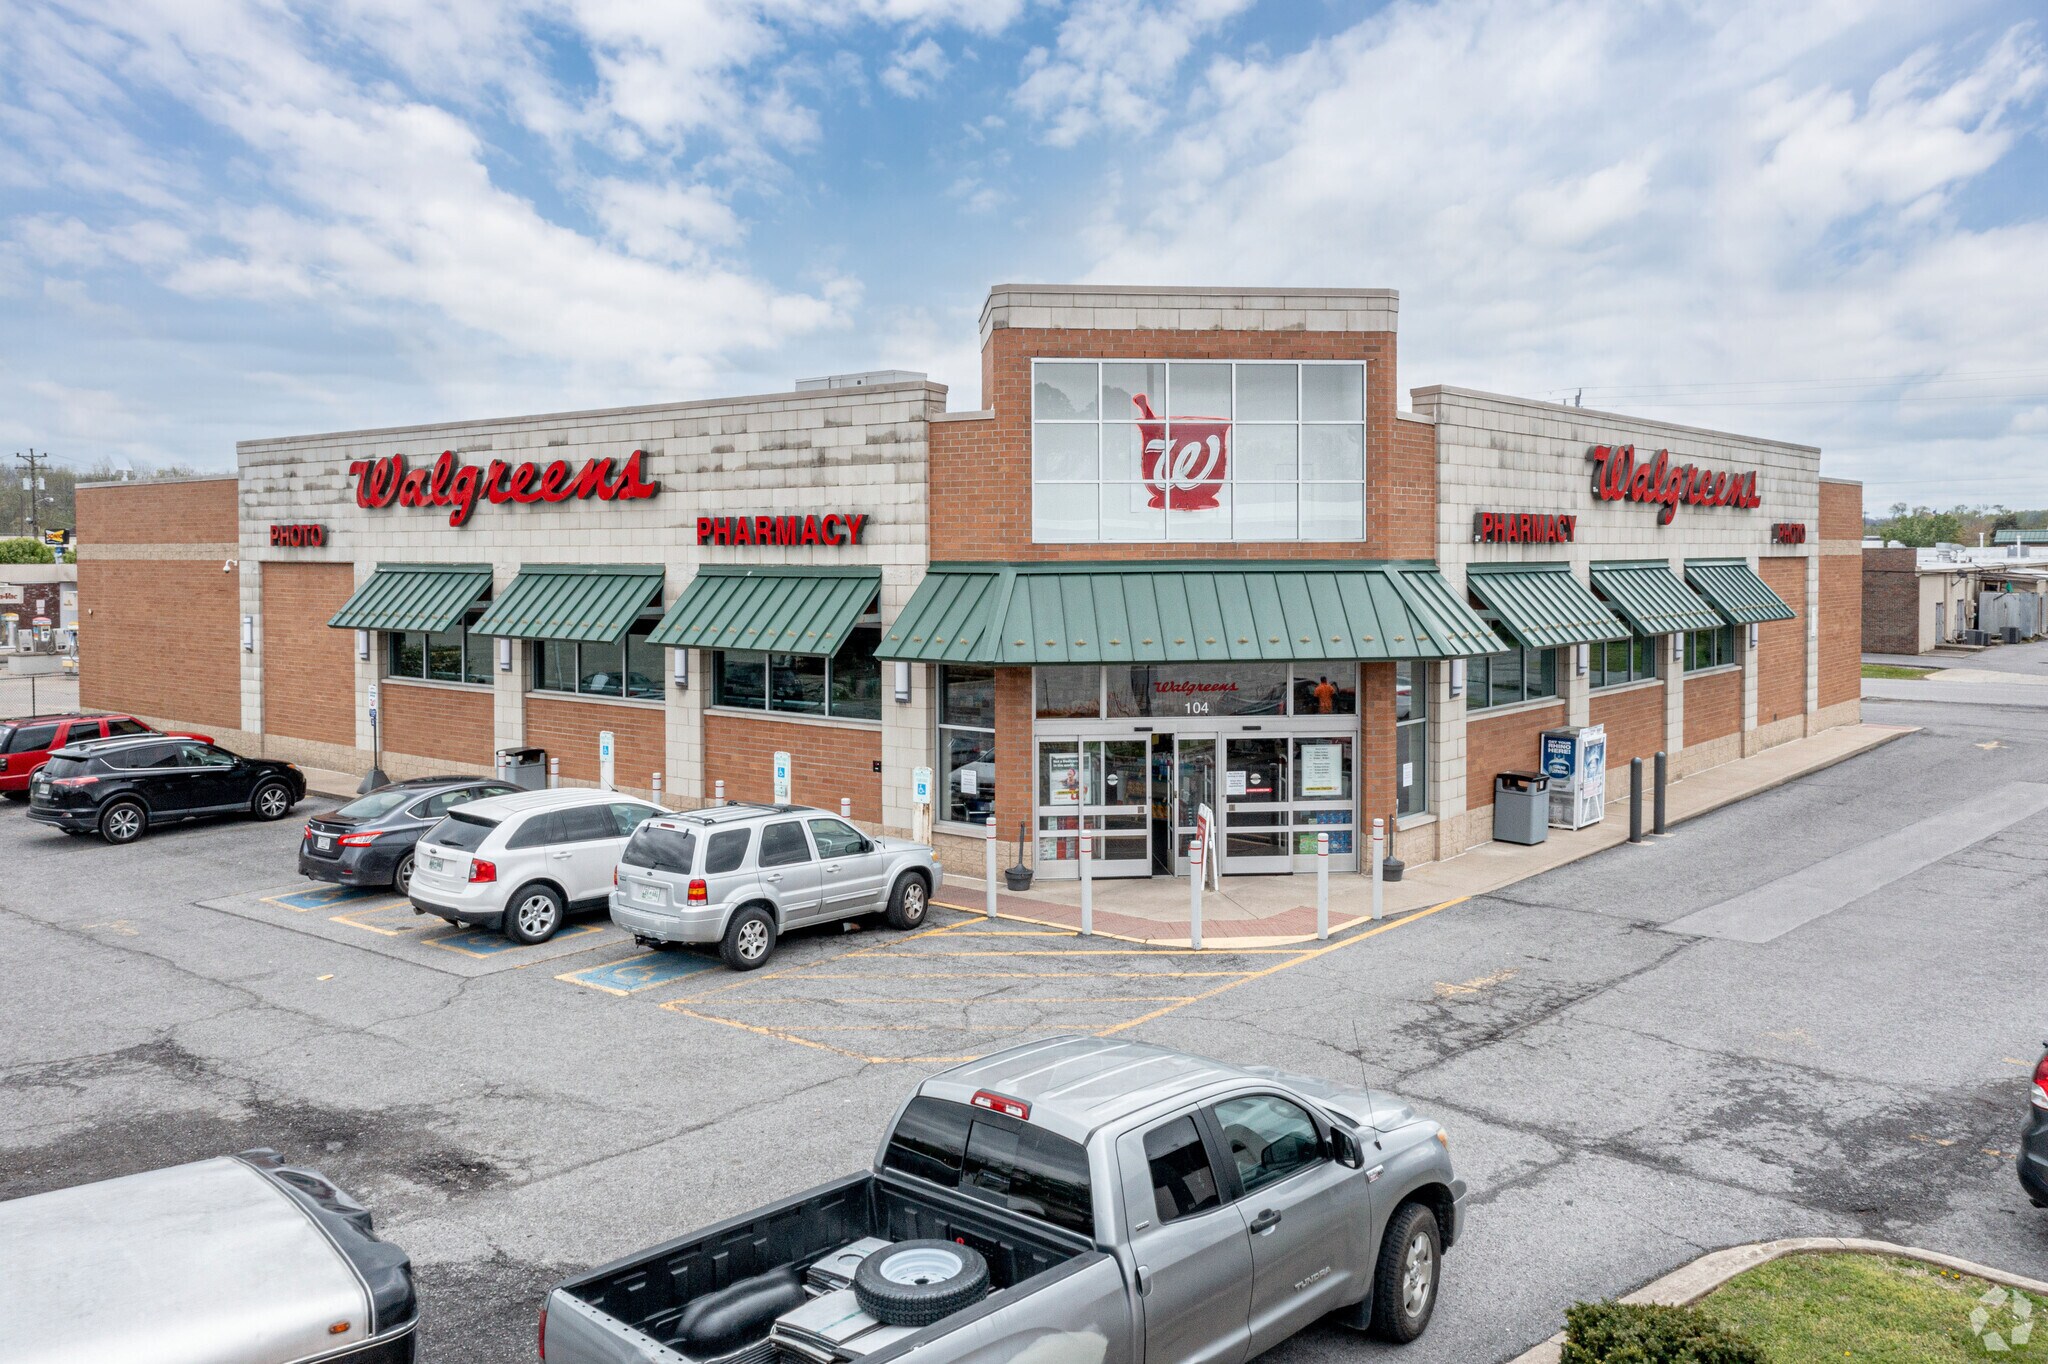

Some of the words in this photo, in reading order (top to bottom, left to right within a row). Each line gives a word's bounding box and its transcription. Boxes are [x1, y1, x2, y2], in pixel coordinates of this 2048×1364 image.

[350, 450, 656, 527] Walgreens
[1592, 444, 1761, 525] Walgreens
[270, 523, 323, 548] PHOTO
[697, 513, 865, 547] PHARMACY
[1481, 511, 1577, 543] PHARMACY
[1778, 523, 1806, 544] PHOTO
[1154, 681, 1239, 696] Walgreens
[1185, 701, 1210, 714] 104
[1295, 1266, 1331, 1290] TUNDRA
